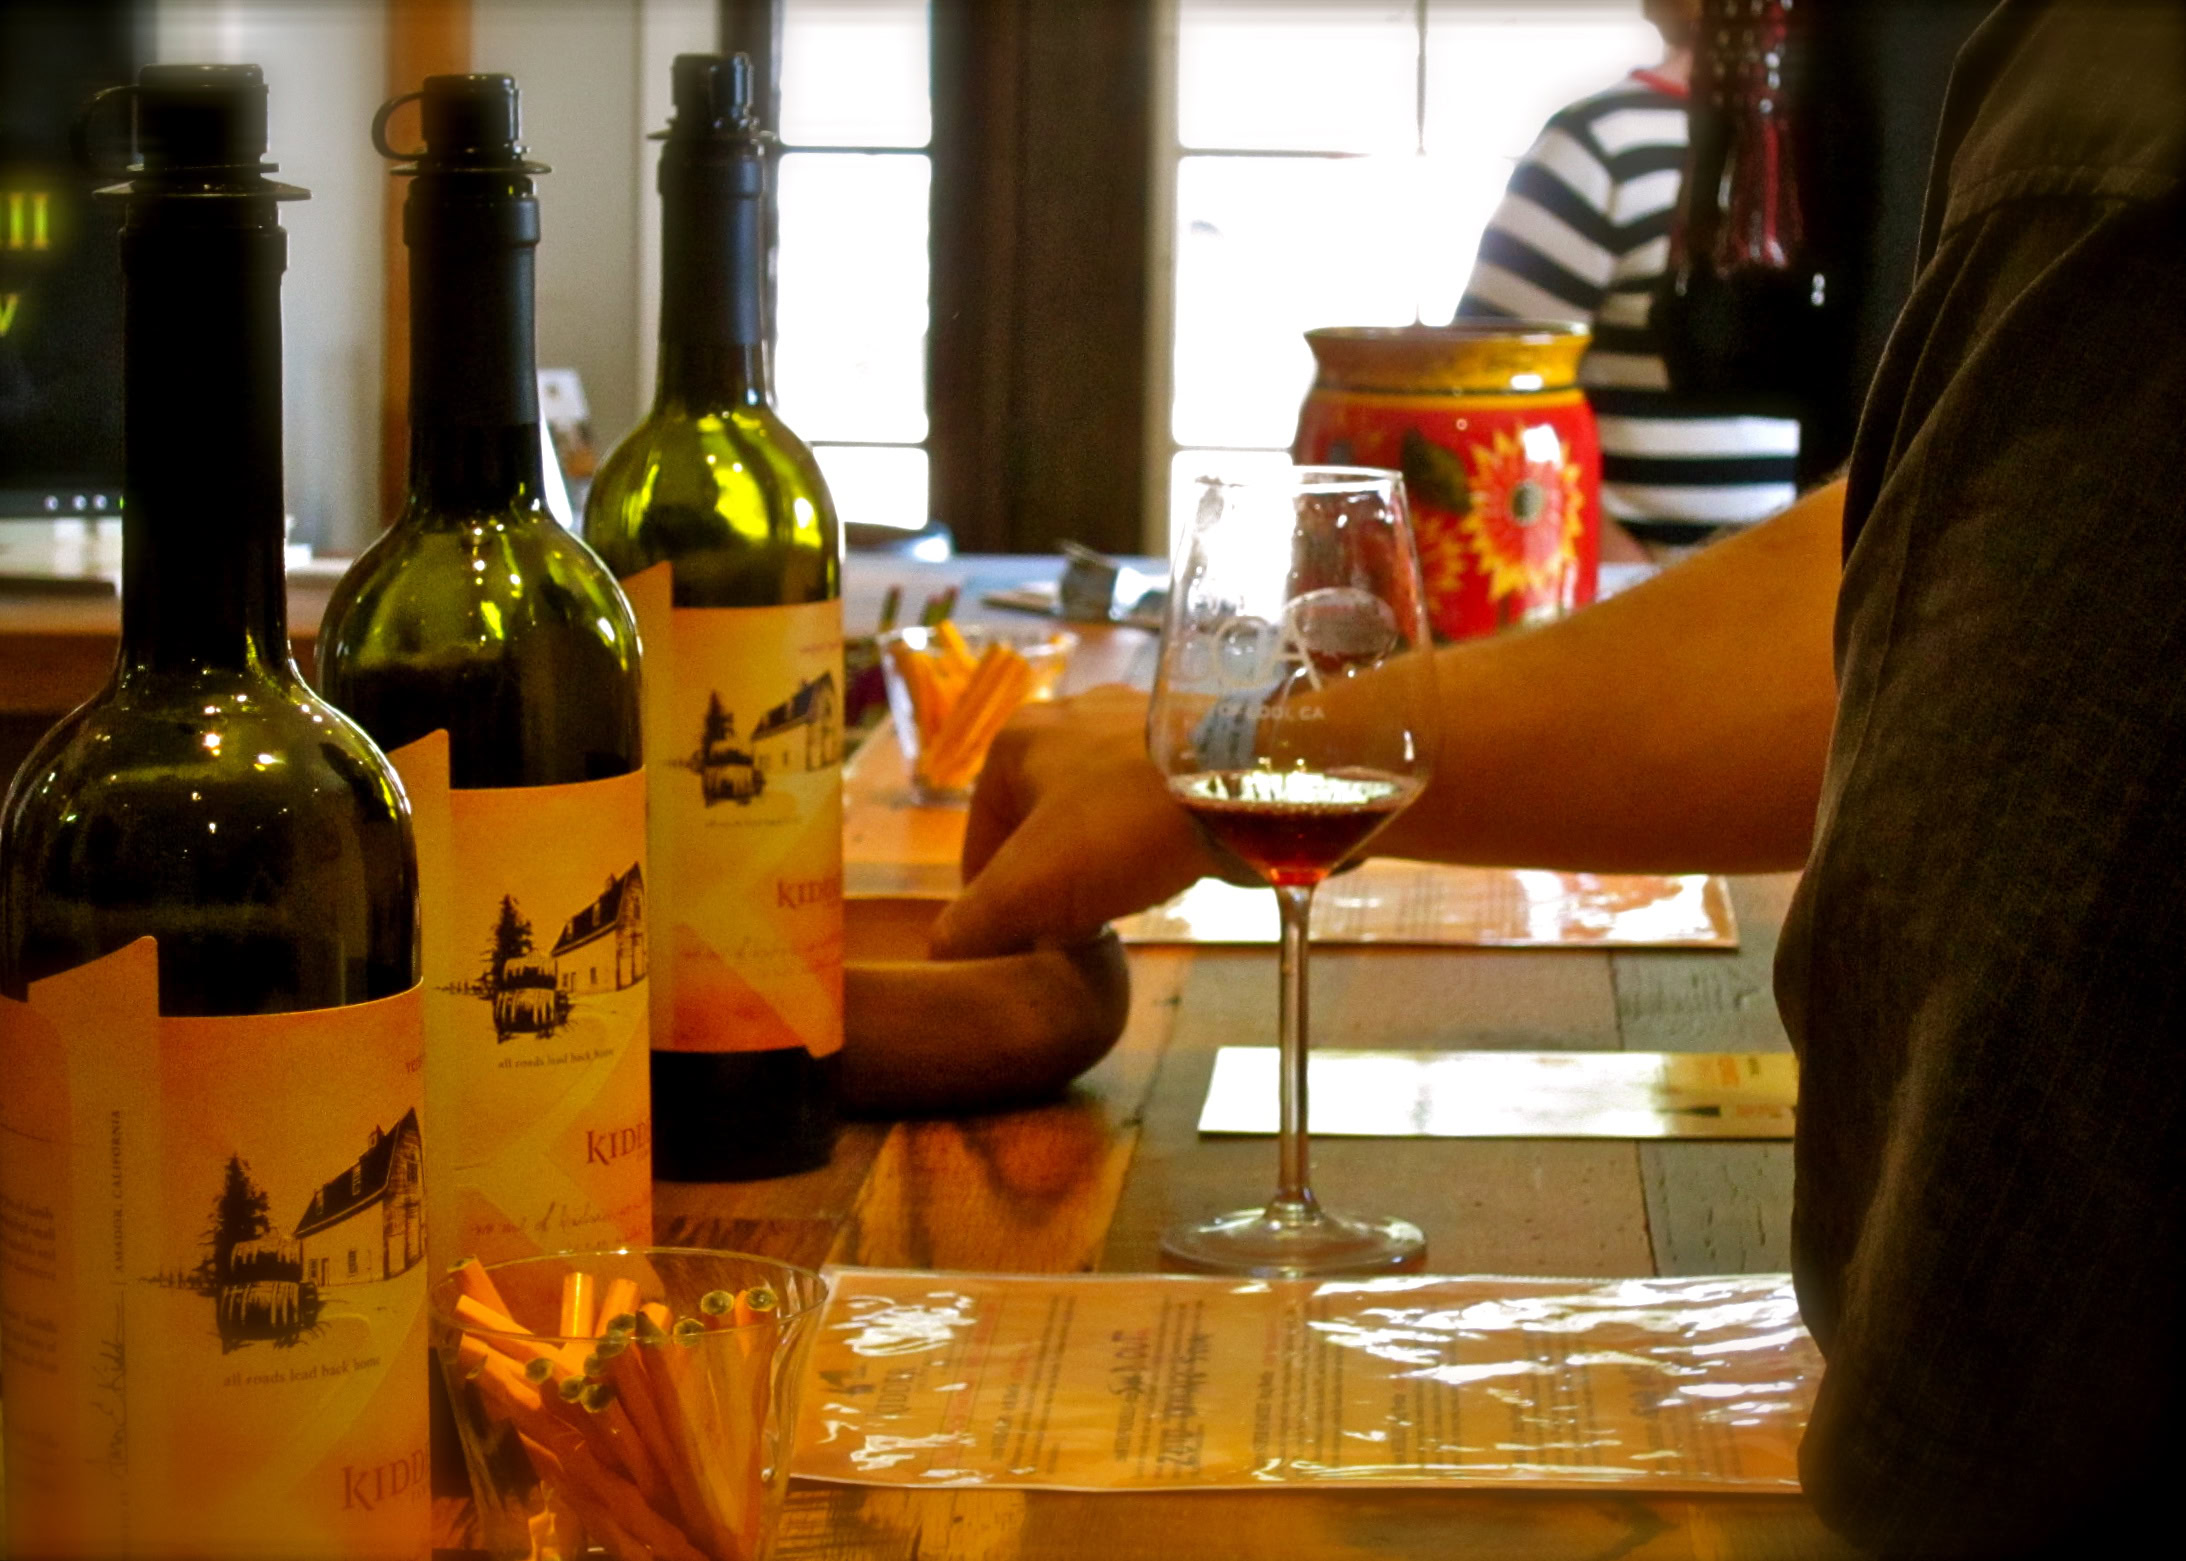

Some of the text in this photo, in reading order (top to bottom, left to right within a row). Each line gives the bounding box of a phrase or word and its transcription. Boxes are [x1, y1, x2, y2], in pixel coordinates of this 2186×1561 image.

[110, 1109, 123, 1200] CALIFORNIA
[224, 1371, 241, 1387] all
[246, 1368, 286, 1386] roads
[290, 1364, 318, 1382] lead
[321, 1359, 349, 1378] back
